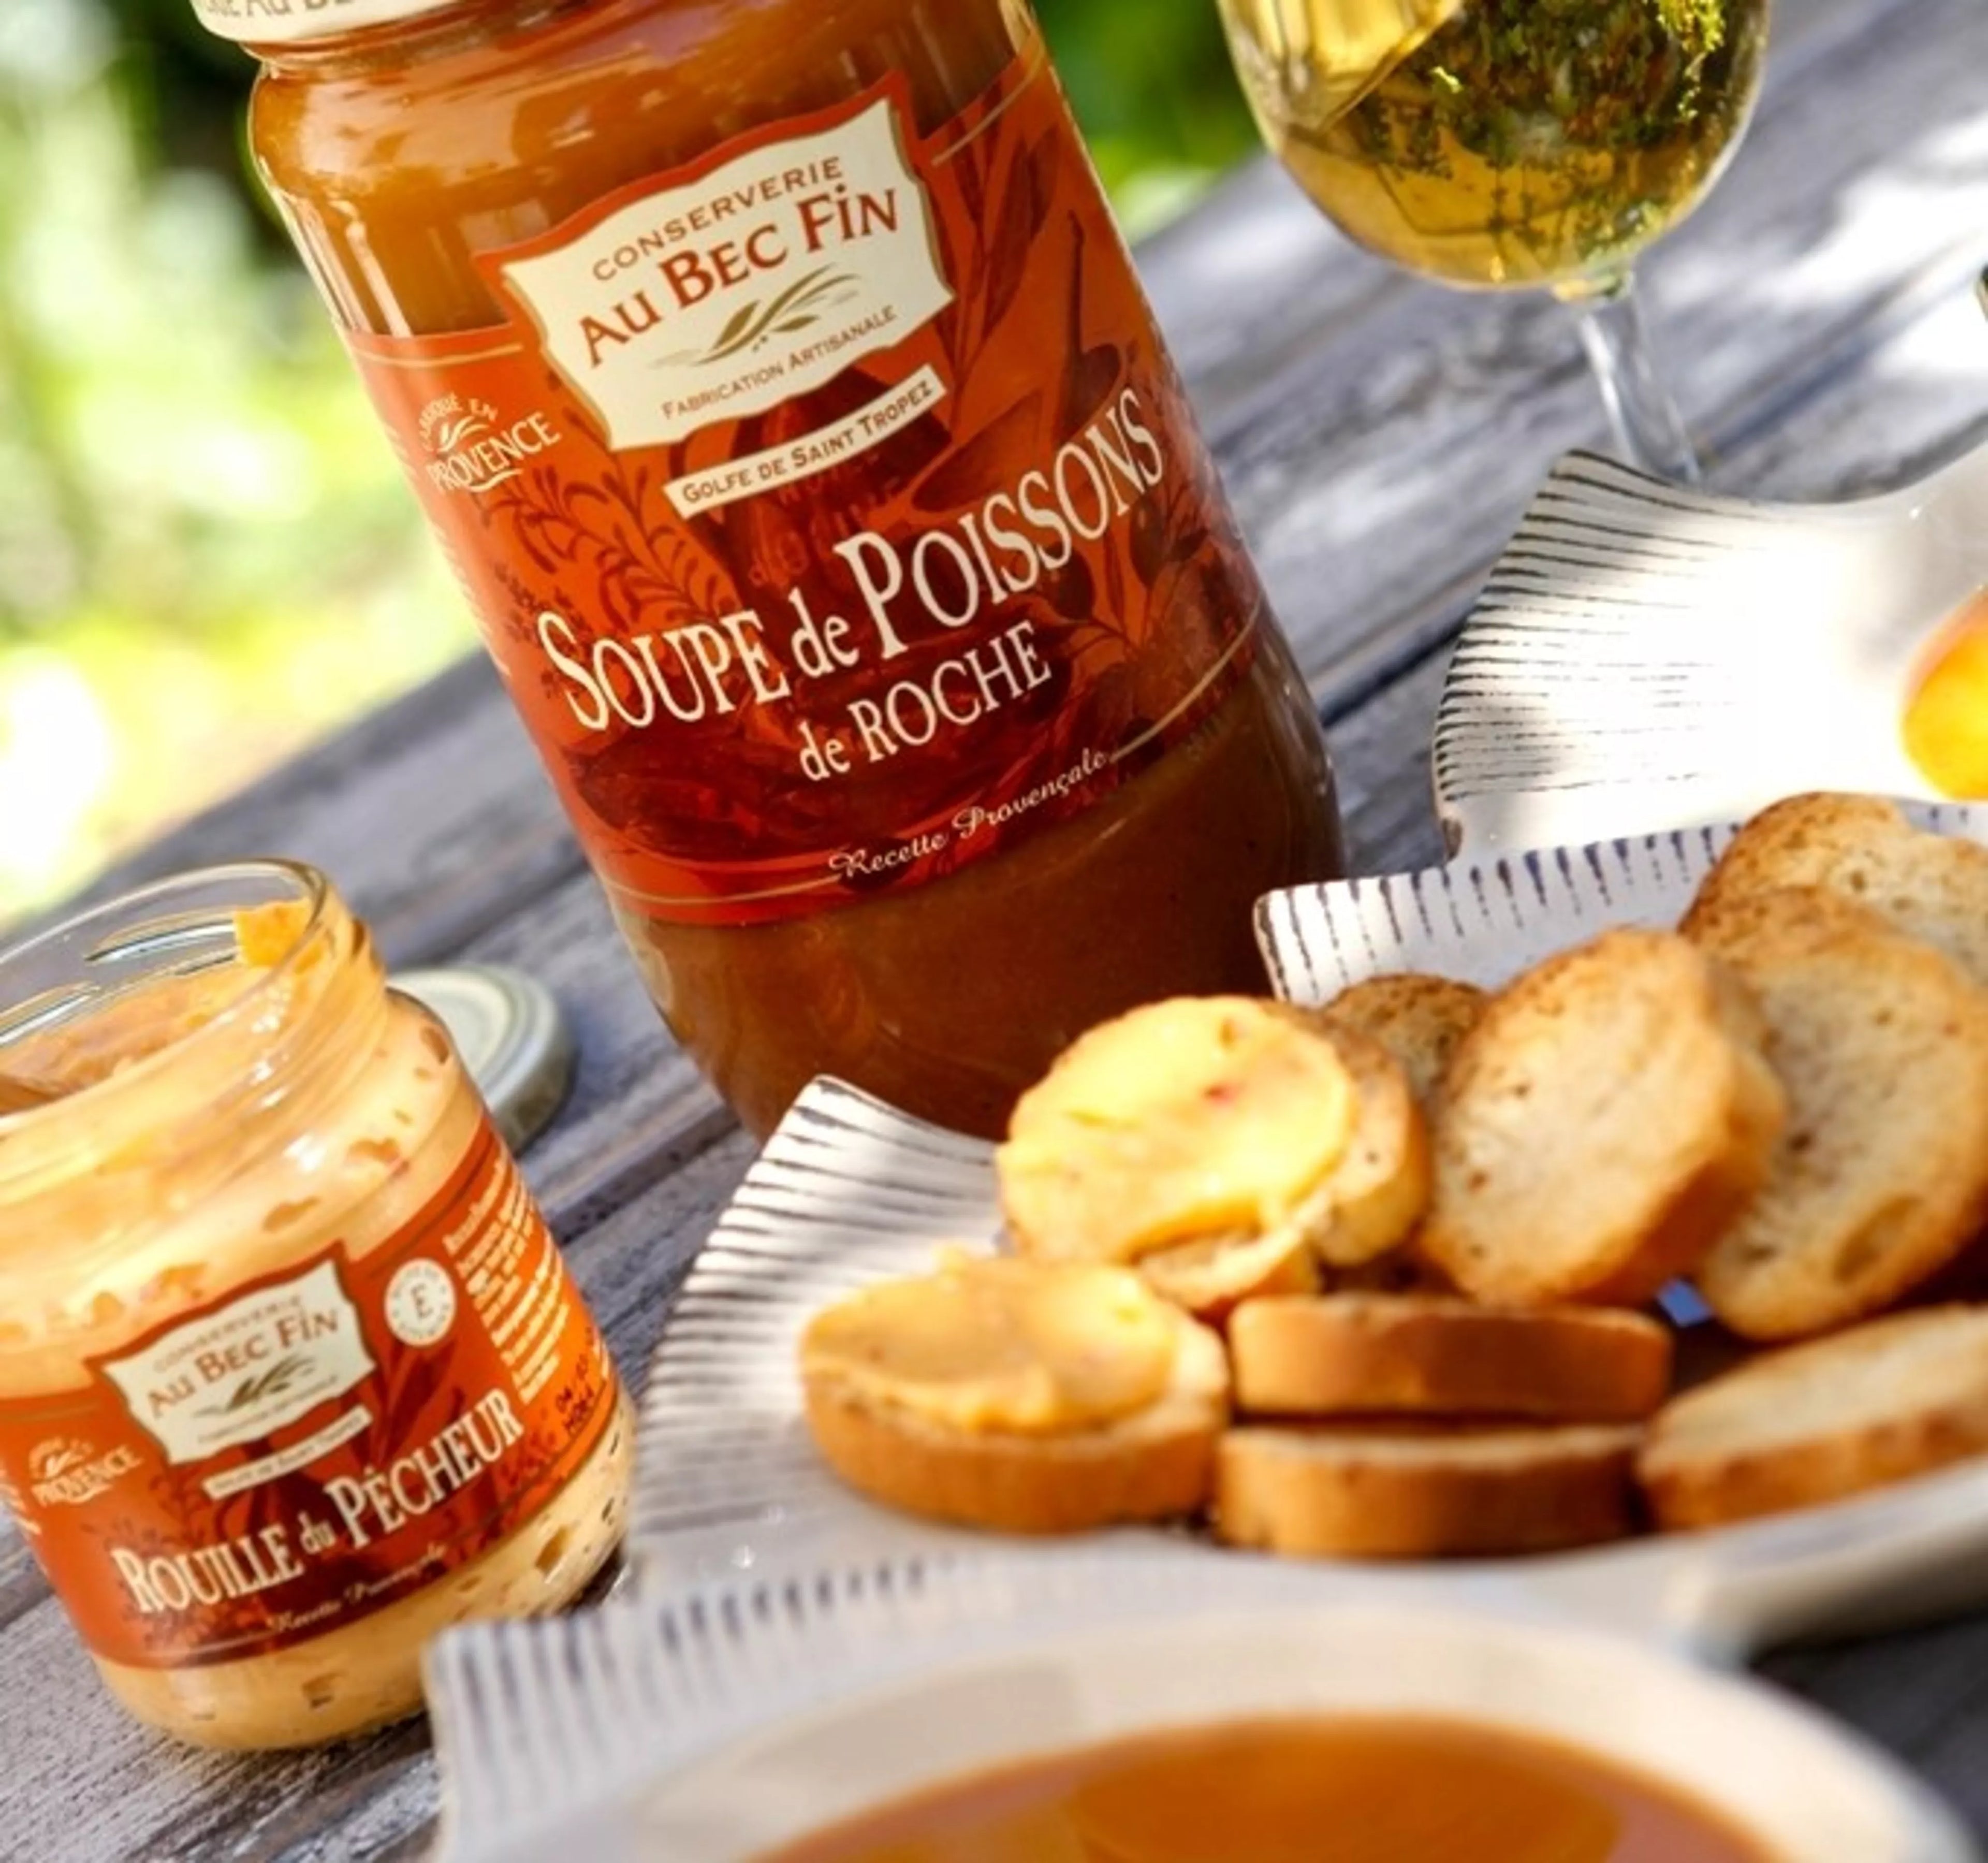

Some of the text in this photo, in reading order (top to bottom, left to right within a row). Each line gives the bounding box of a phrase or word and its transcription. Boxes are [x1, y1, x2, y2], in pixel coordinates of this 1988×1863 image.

[593, 156, 842, 282] CONSERVERIE
[658, 224, 787, 310] BEC
[661, 305, 897, 419] FABRICATION ARTISANALE
[426, 412, 561, 493] PROVENCE
[683, 468, 752, 504] GOLFE
[758, 460, 786, 481] DE
[792, 429, 855, 467] SAINT
[858, 380, 932, 436] TROPEZ
[538, 611, 791, 730] SOUPE
[789, 587, 859, 678] de
[835, 388, 1163, 659] POISSONS
[798, 620, 1051, 782] de ROCHE
[829, 748, 1108, 877] Recette Provençale
[110, 1522, 304, 1613] ROUILLE
[297, 1510, 336, 1553] du
